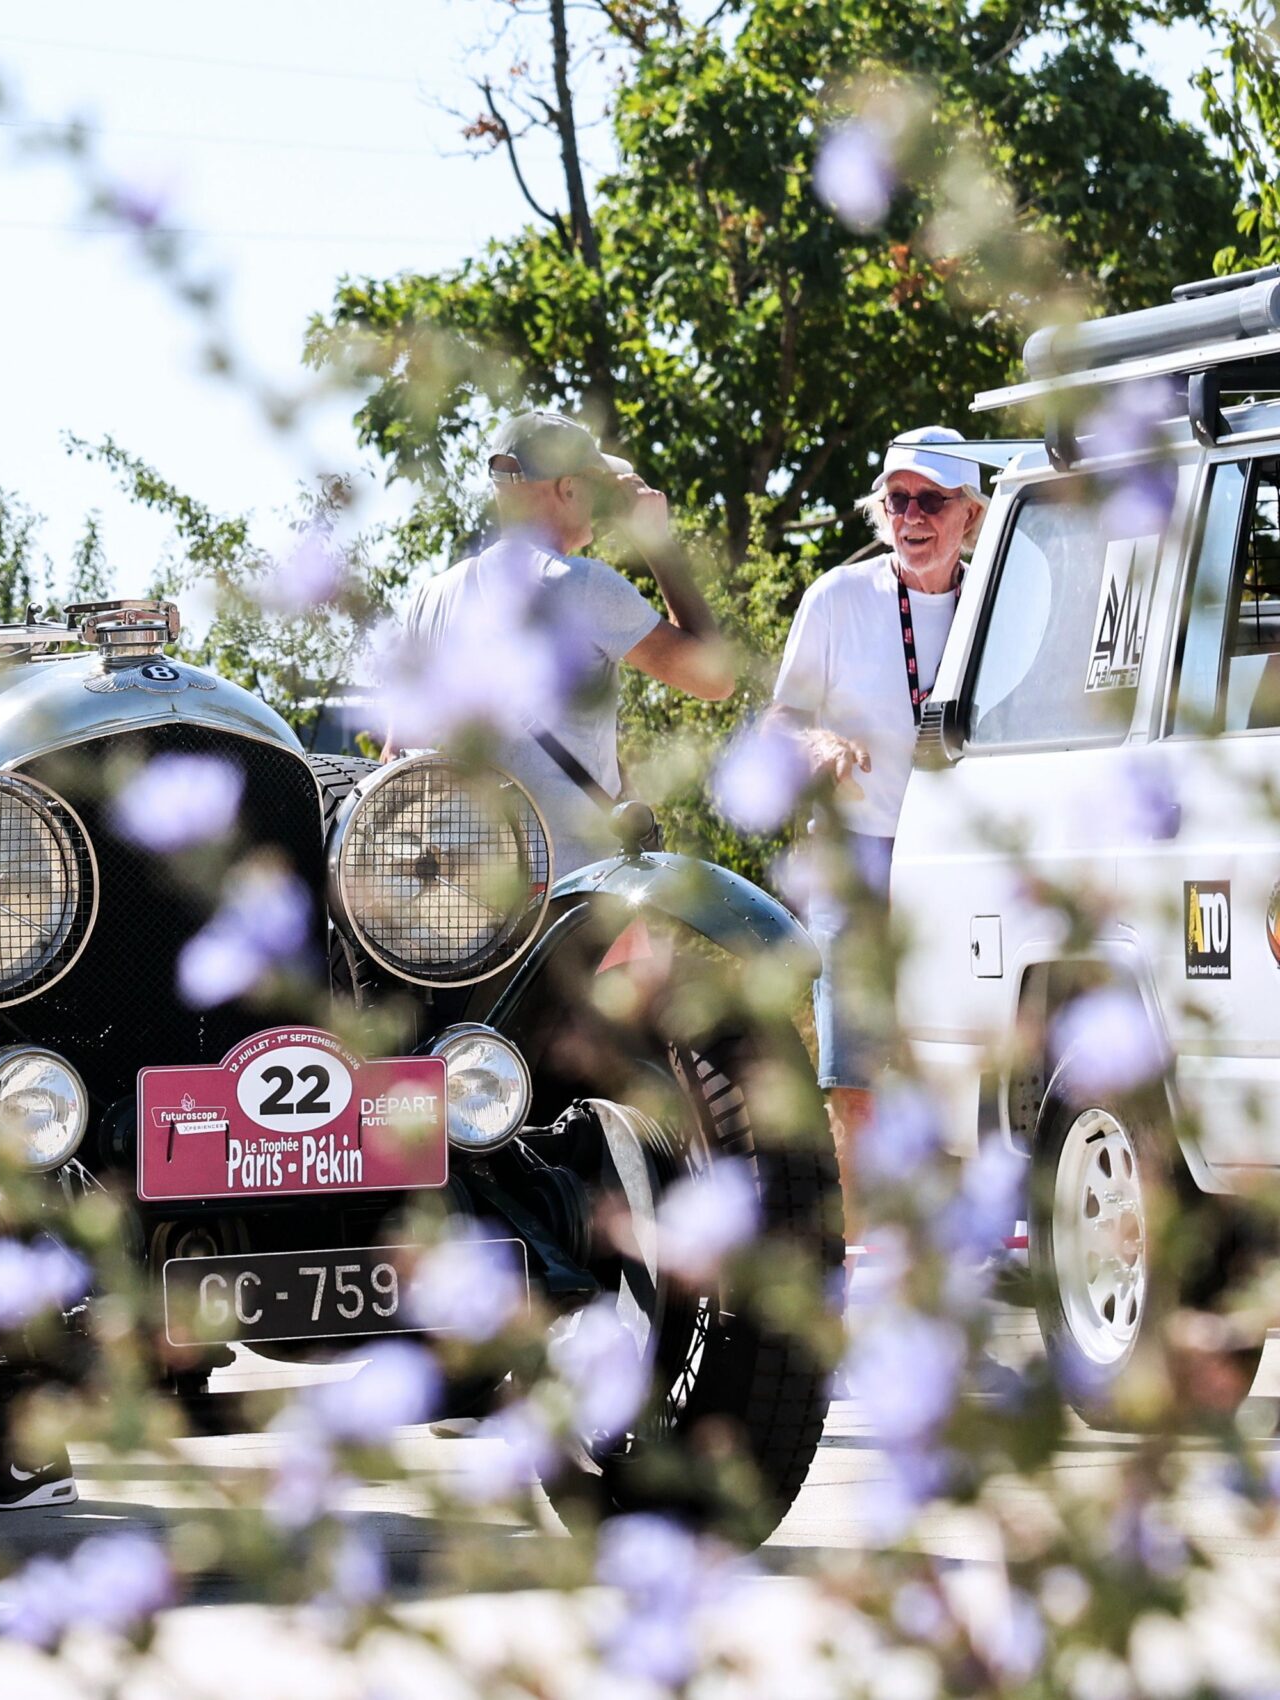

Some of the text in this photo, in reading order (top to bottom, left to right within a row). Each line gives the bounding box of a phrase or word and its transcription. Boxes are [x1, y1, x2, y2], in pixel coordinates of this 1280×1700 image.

[147, 666, 175, 680] B
[1188, 883, 1229, 954] ATO
[228, 1062, 240, 1073] 12
[238, 1038, 270, 1065] JUILLET
[289, 1033, 341, 1054] SEPTEMBRE
[341, 1050, 361, 1071] 2026
[259, 1064, 331, 1115] 22
[360, 1094, 438, 1115] DÉPART
[160, 1111, 219, 1123] futuroscope
[183, 1123, 224, 1132] XPERIENCES
[245, 1137, 299, 1154] Le Trophée
